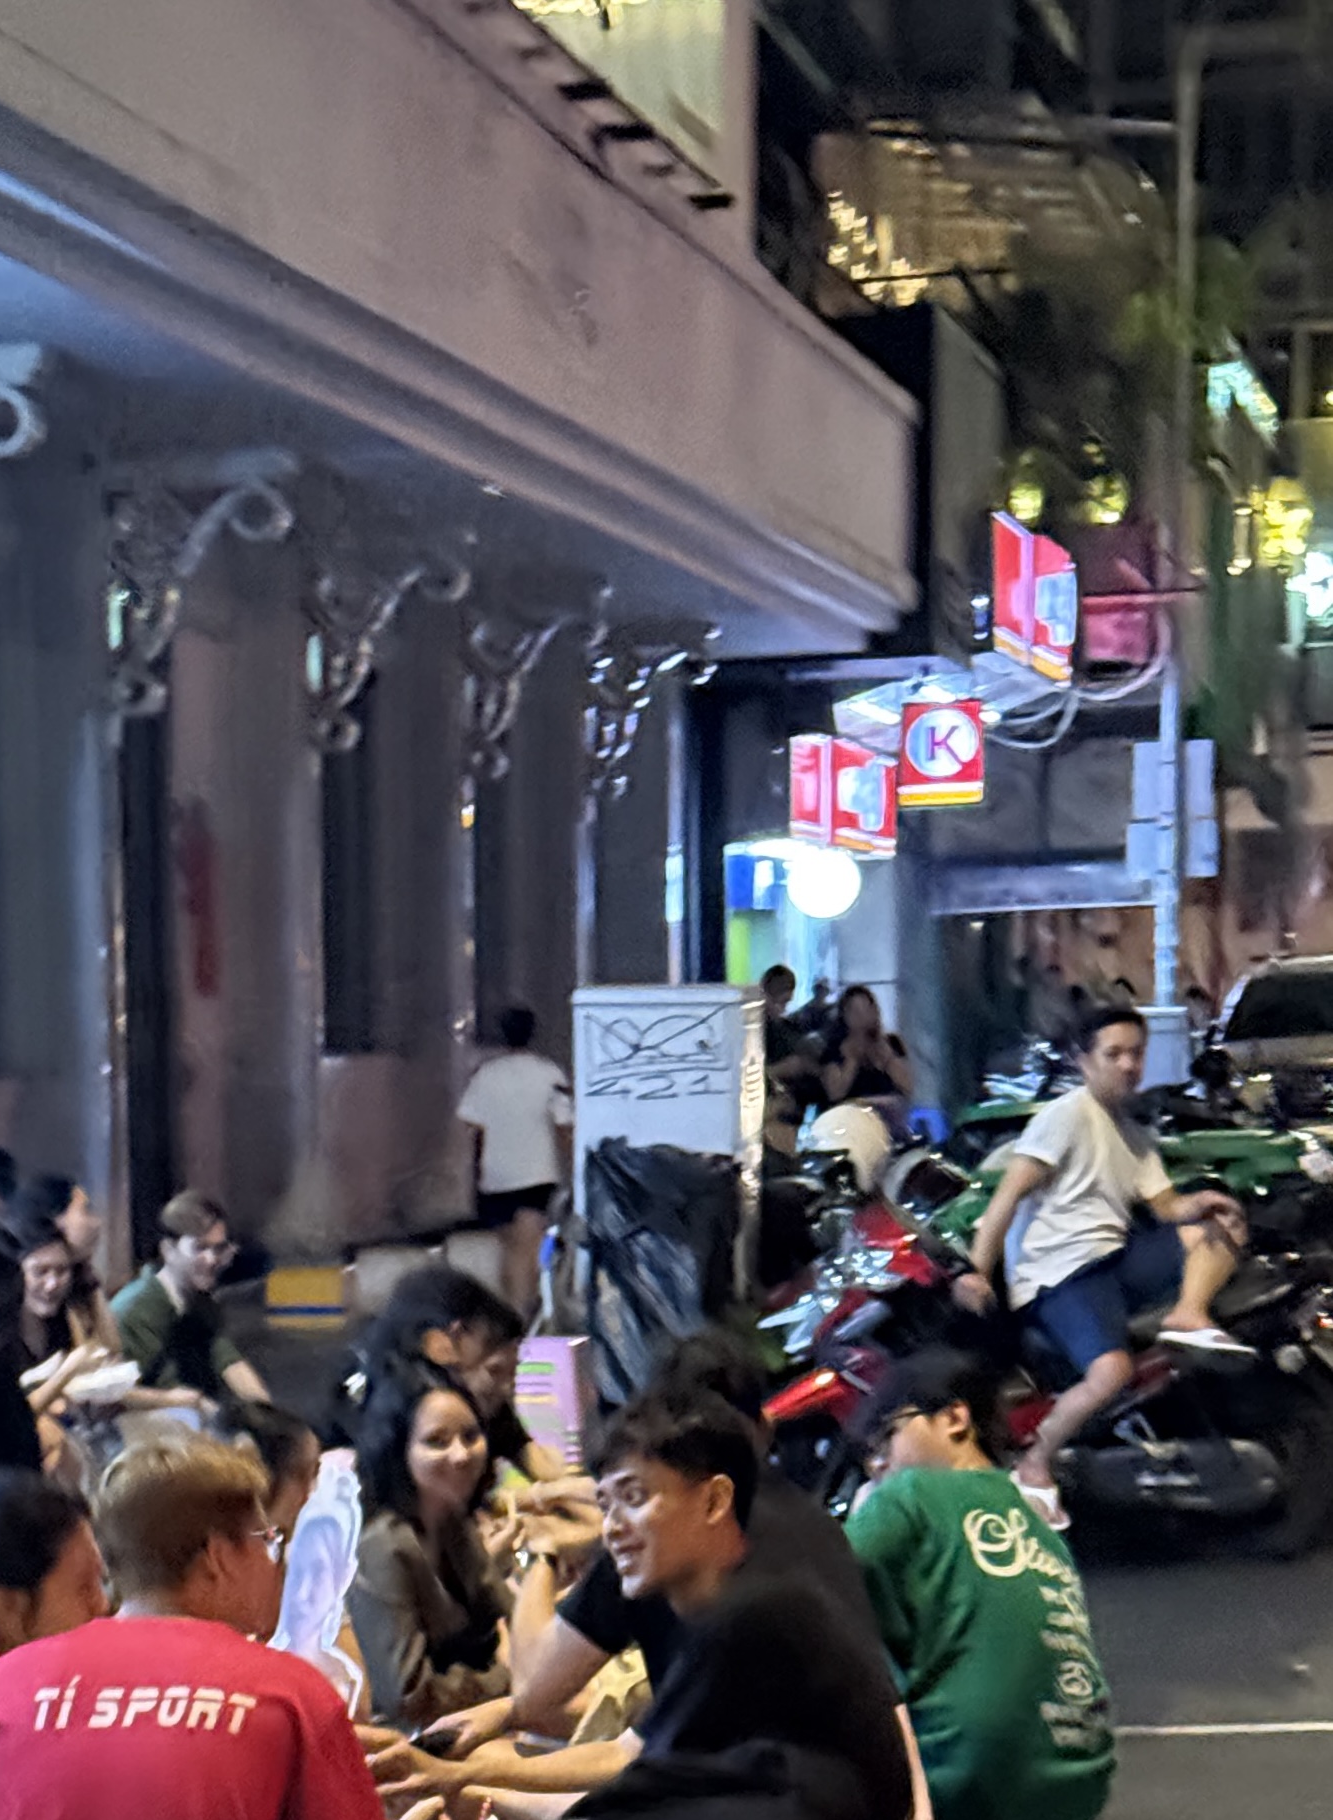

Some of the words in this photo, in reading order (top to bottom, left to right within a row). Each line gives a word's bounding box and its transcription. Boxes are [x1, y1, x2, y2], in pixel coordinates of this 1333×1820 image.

[928, 725, 962, 763] K
[33, 1674, 82, 1731] TÍ
[87, 1685, 258, 1736] SPORT
